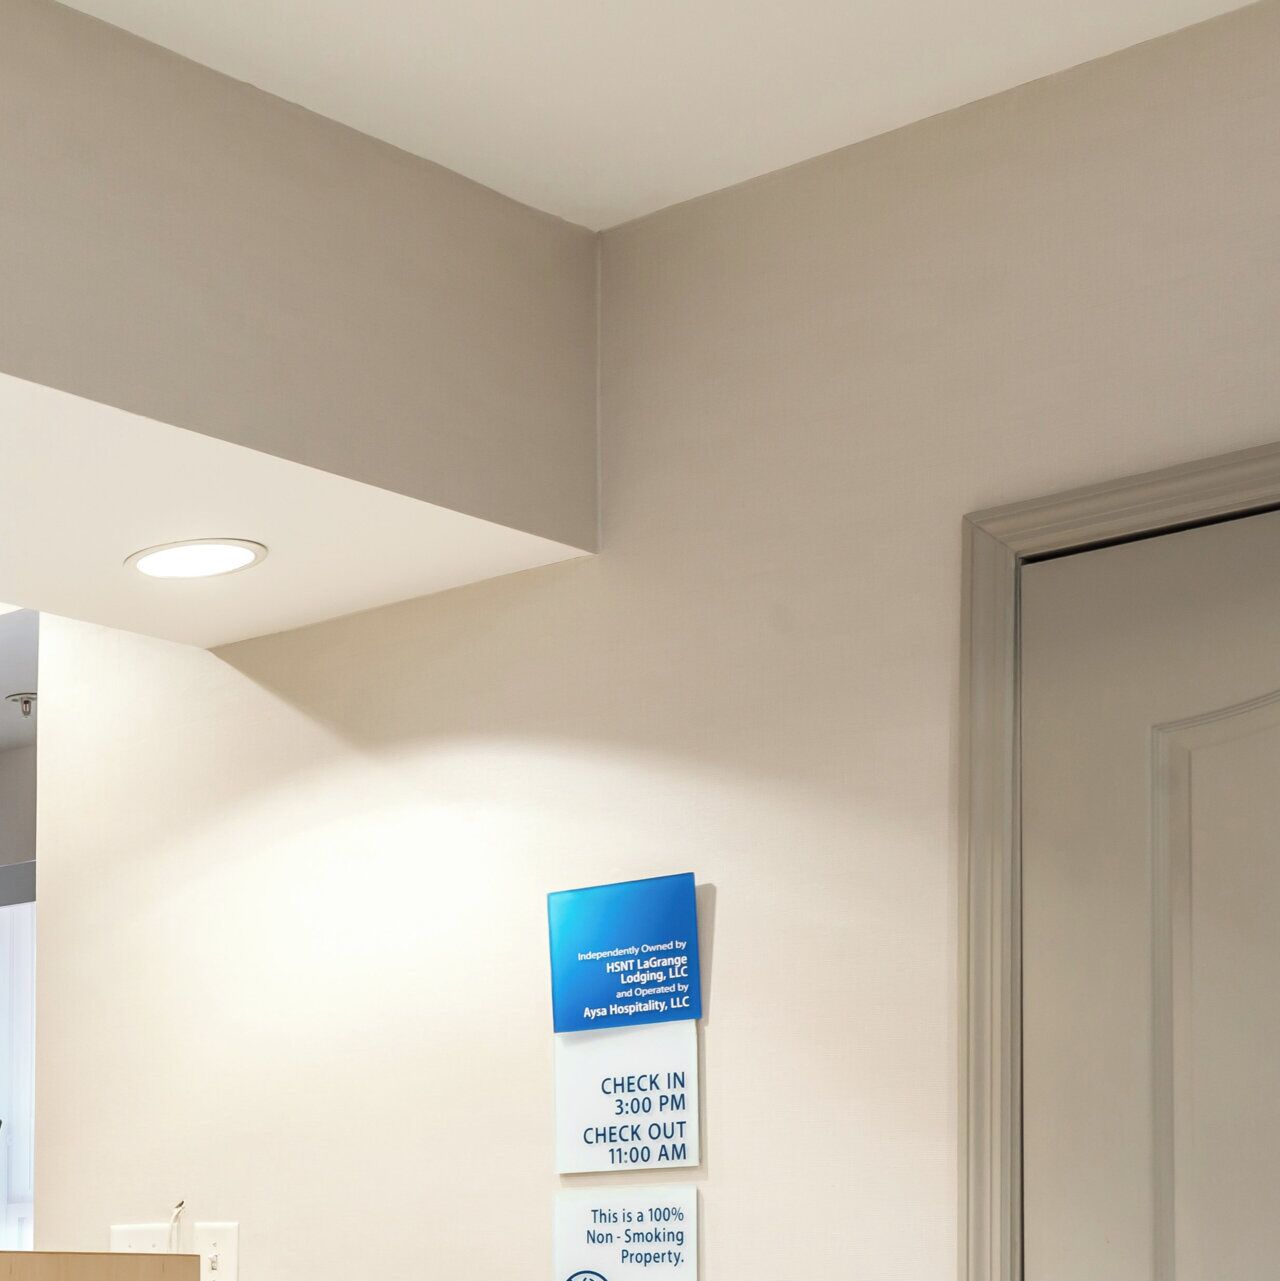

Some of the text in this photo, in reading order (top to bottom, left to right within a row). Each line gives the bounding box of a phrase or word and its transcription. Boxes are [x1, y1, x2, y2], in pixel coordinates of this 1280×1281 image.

[577, 940, 687, 961] Independently Owned by
[606, 955, 688, 973] HSNT LaGrange
[620, 966, 688, 984] Lodging, LLC
[616, 982, 689, 998] and Operated by
[583, 996, 690, 1020] Aysa Hospitality, LLC
[601, 1071, 685, 1095] CHECK IN
[615, 1093, 686, 1115] 3:00 PM
[583, 1121, 687, 1144] CHECK OUT
[608, 1143, 687, 1164] 11:00 AM
[590, 1206, 684, 1223] This is a 100%
[586, 1229, 613, 1244] Non
[624, 1227, 684, 1246] Smoking
[621, 1249, 684, 1267] Property.
